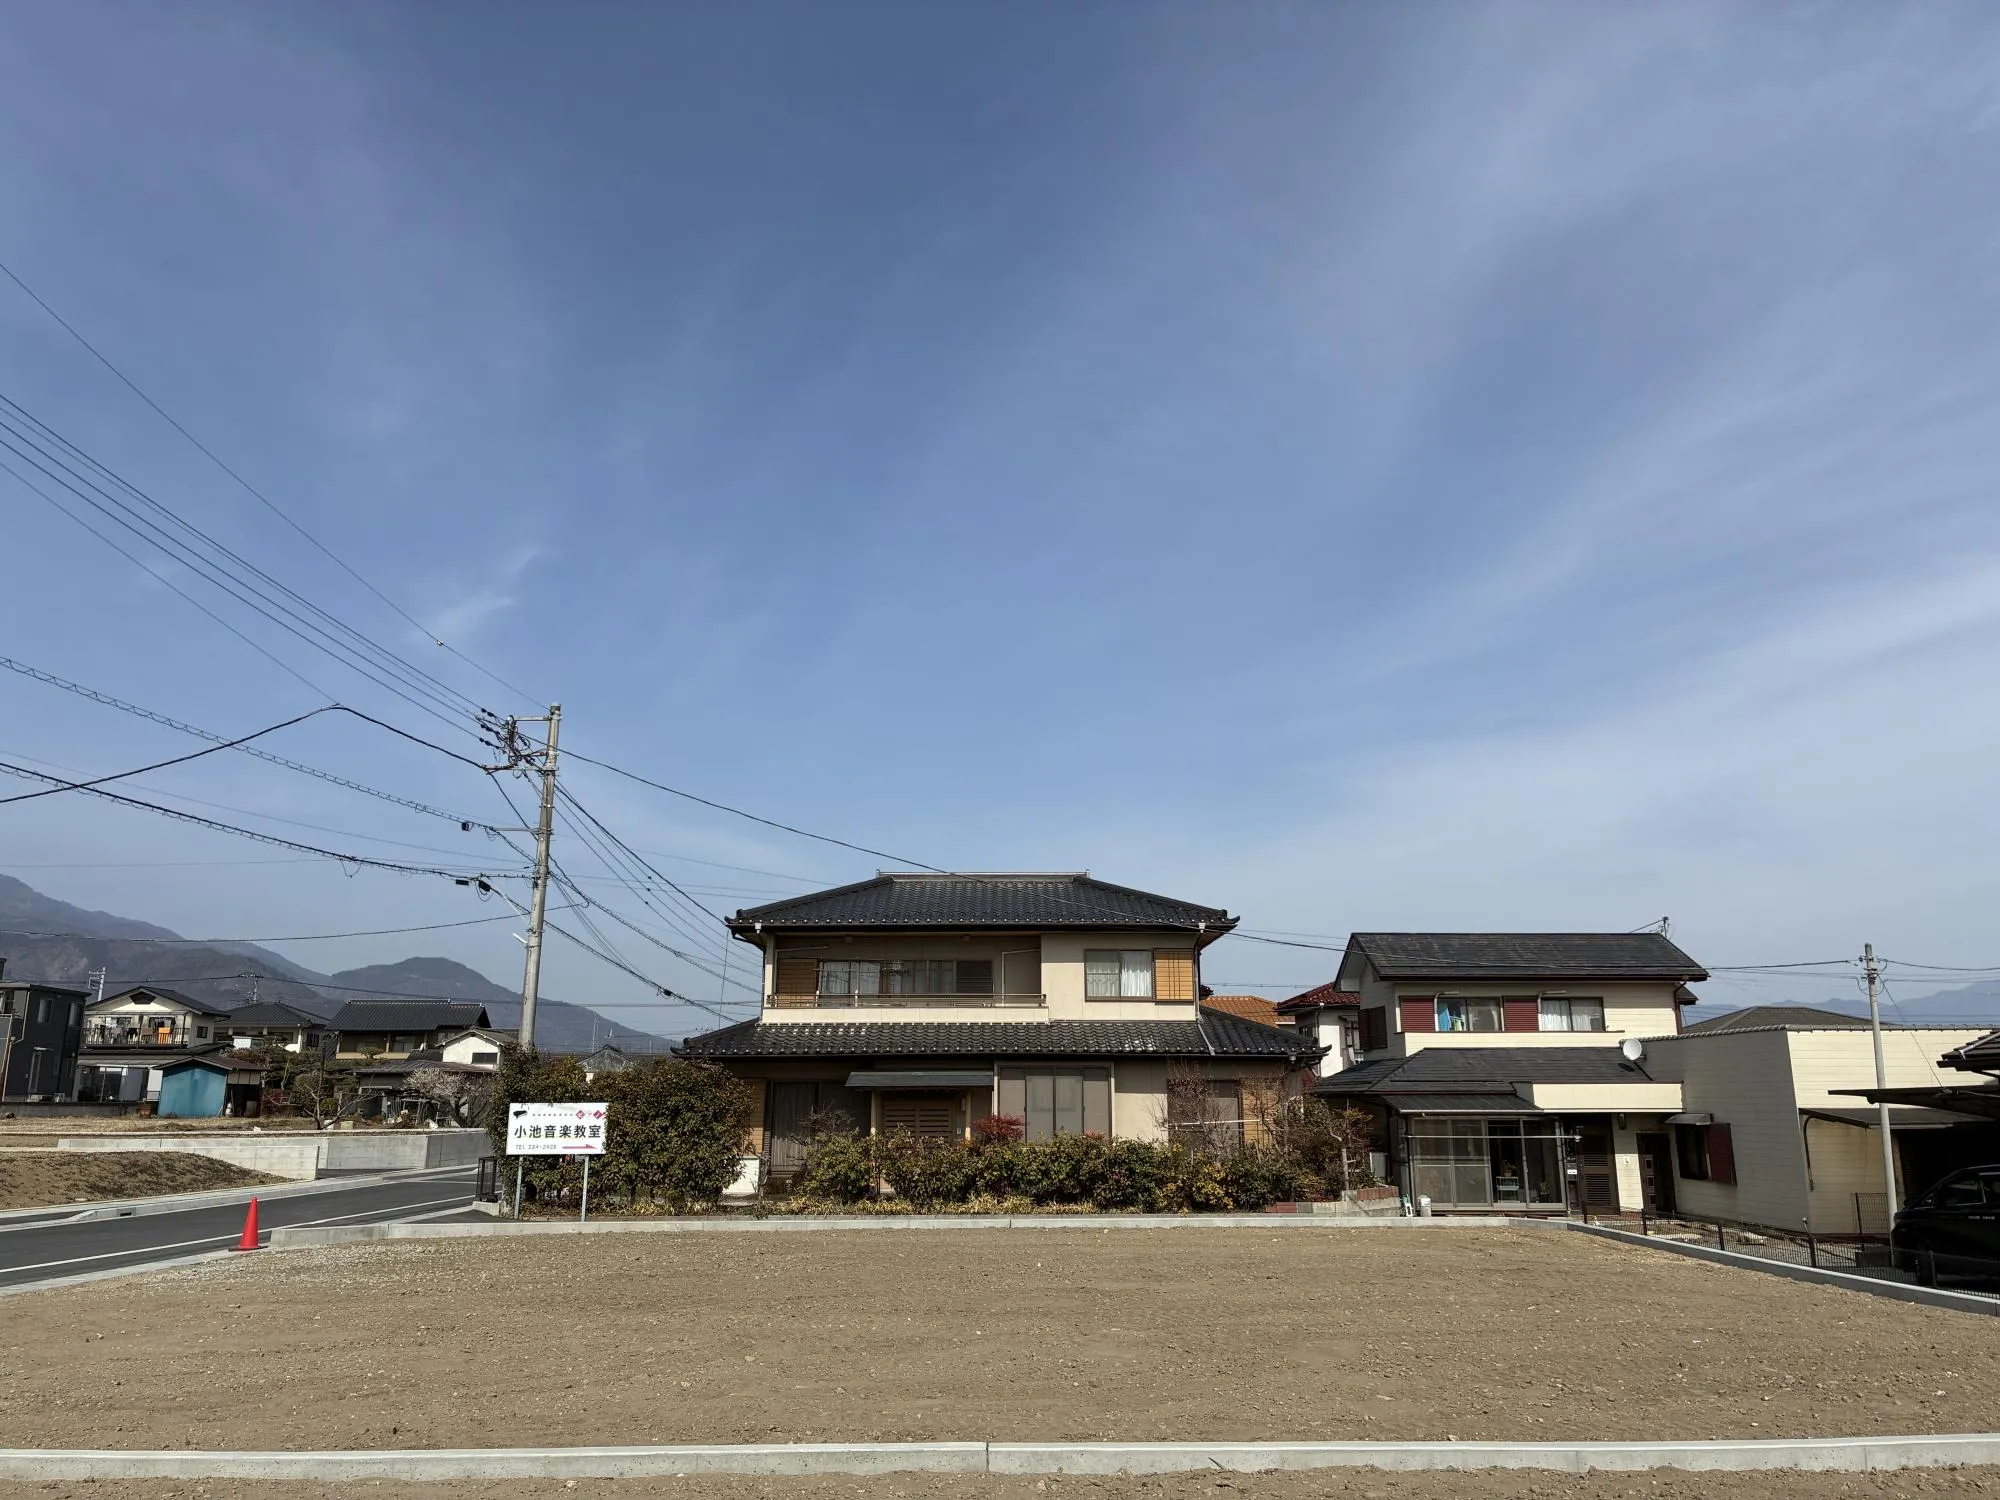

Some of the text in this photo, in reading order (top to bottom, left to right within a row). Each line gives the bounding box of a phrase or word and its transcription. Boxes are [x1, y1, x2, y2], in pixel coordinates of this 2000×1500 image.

[514, 1124, 601, 1139] 小池音楽教室
